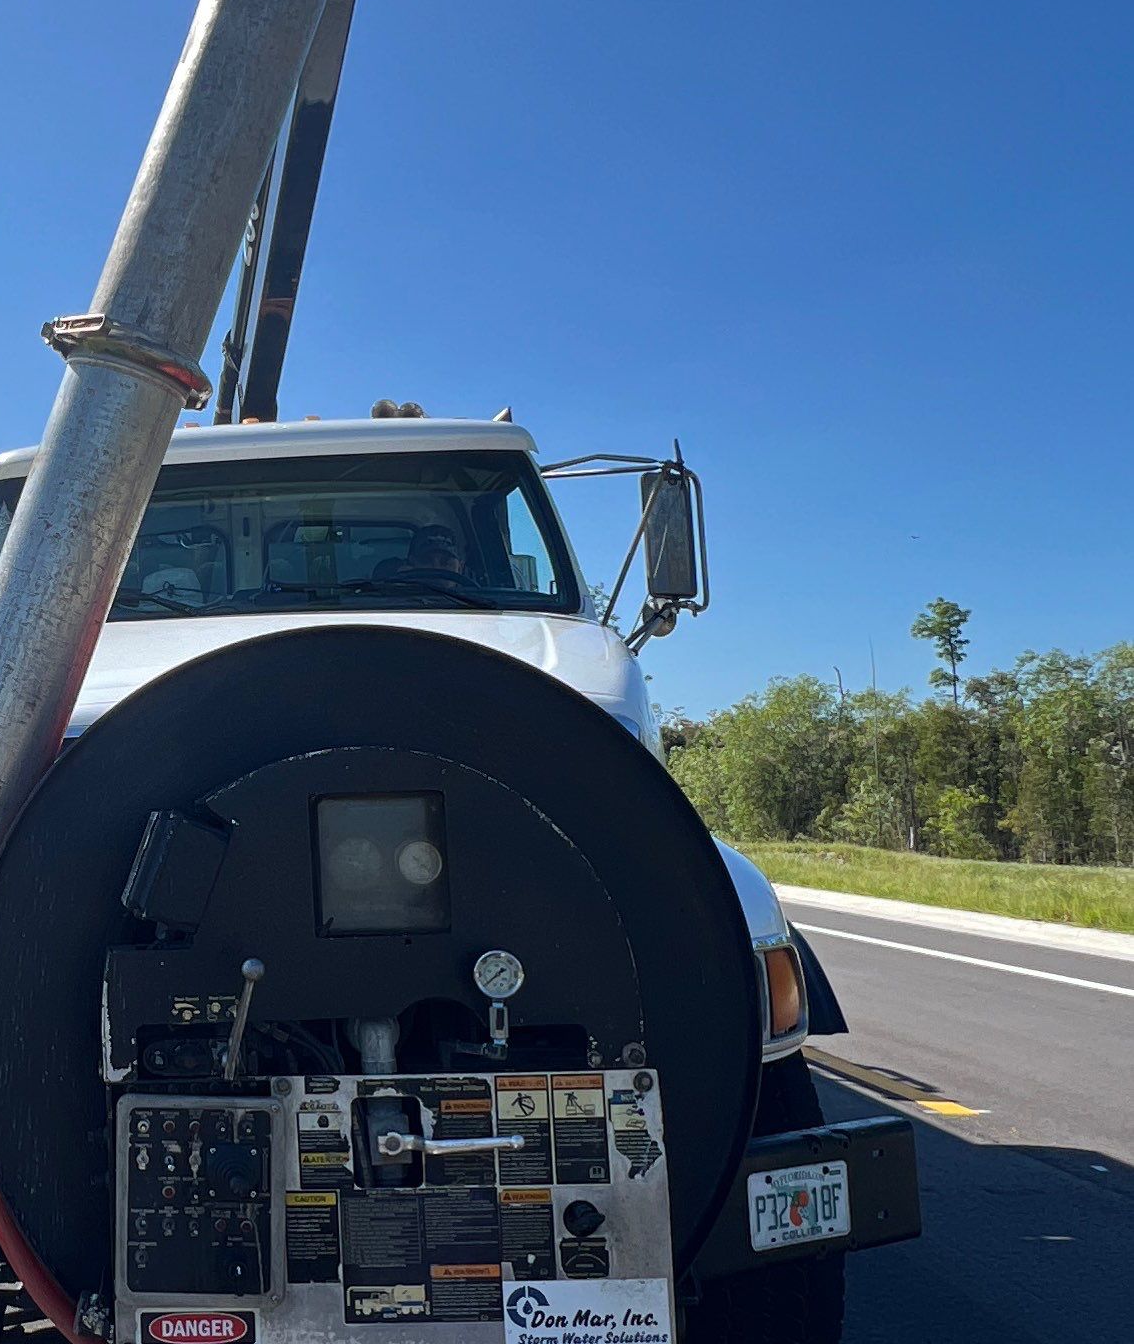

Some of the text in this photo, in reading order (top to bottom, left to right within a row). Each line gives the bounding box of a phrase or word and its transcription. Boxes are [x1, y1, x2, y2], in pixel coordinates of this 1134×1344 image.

[294, 1195, 326, 1203] CAUTION
[531, 1308, 659, 1329] Don Mar, Inc.
[161, 1319, 234, 1337] DANGER
[562, 1332, 603, 1344] Water
[604, 1331, 668, 1344] Solutions
